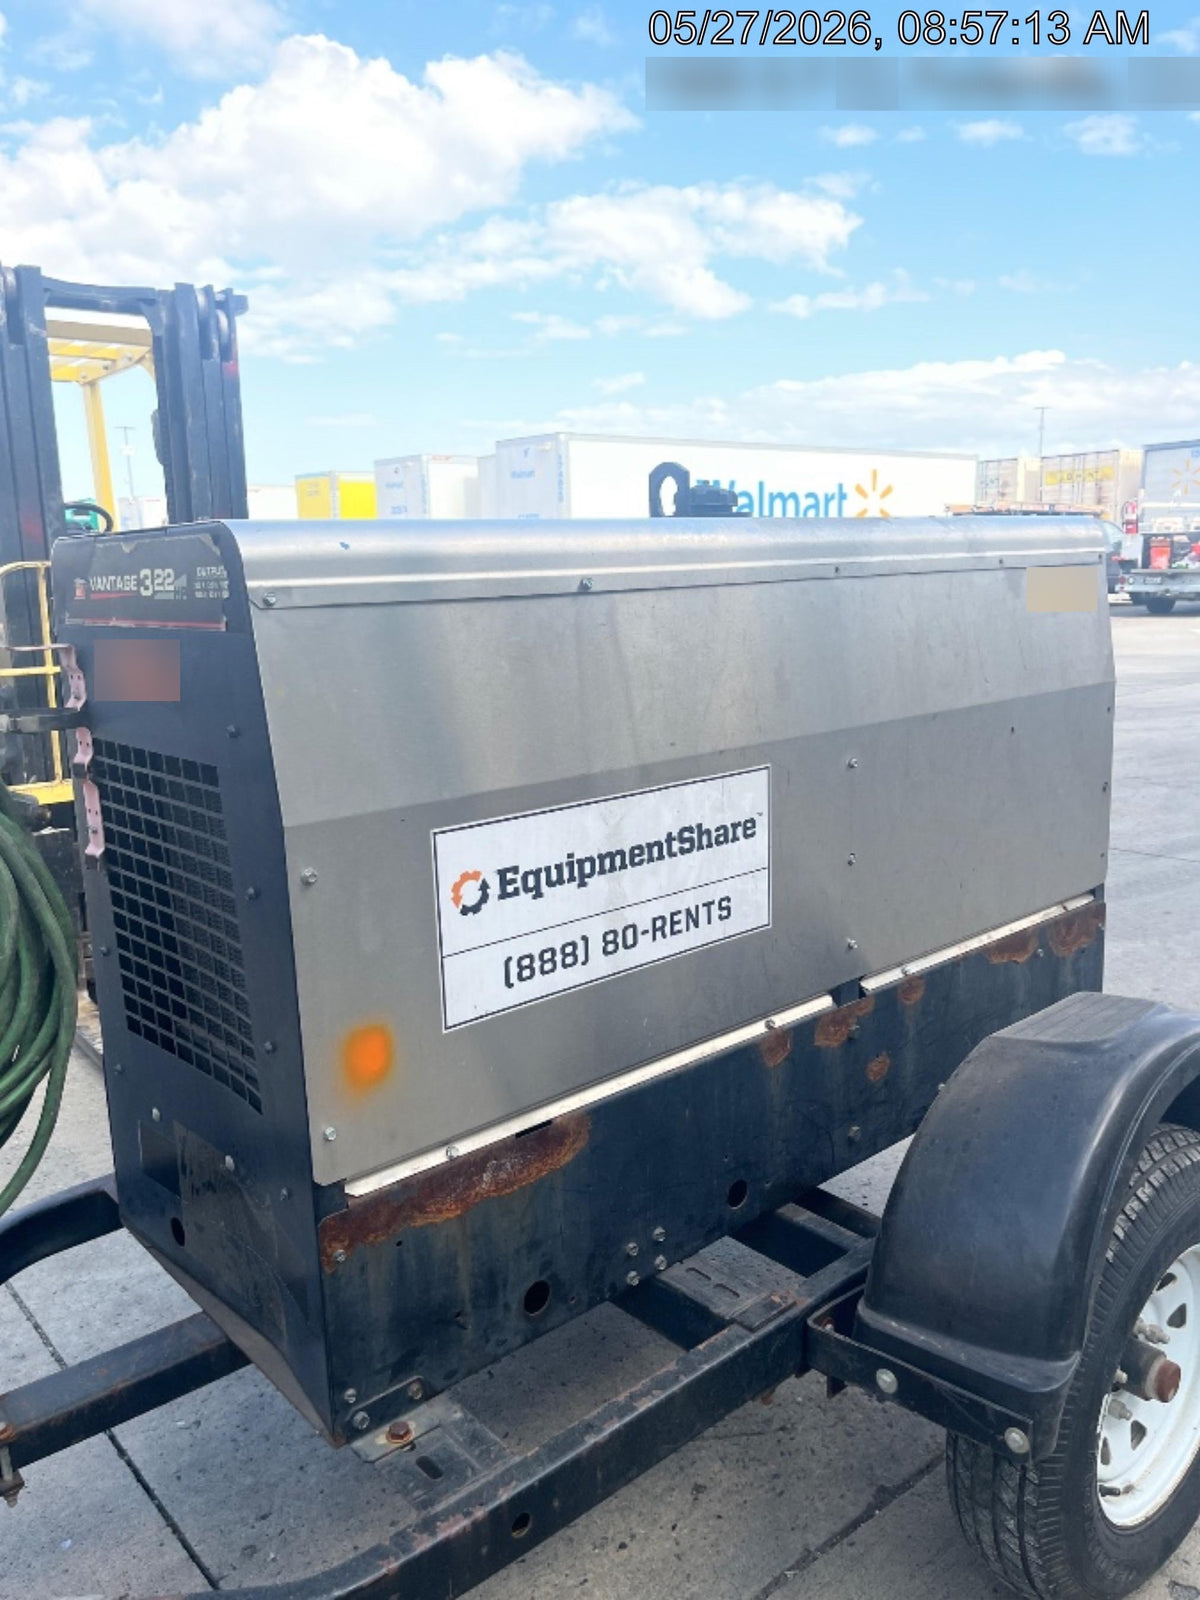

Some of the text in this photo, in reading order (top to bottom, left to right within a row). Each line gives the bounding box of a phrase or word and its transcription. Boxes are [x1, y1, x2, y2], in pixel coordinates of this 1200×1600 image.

[89, 575, 138, 592] VANTAGE
[140, 568, 175, 597] 322
[497, 816, 757, 900] EquipmentShare
[503, 896, 732, 989] (888) 80-RENTS
